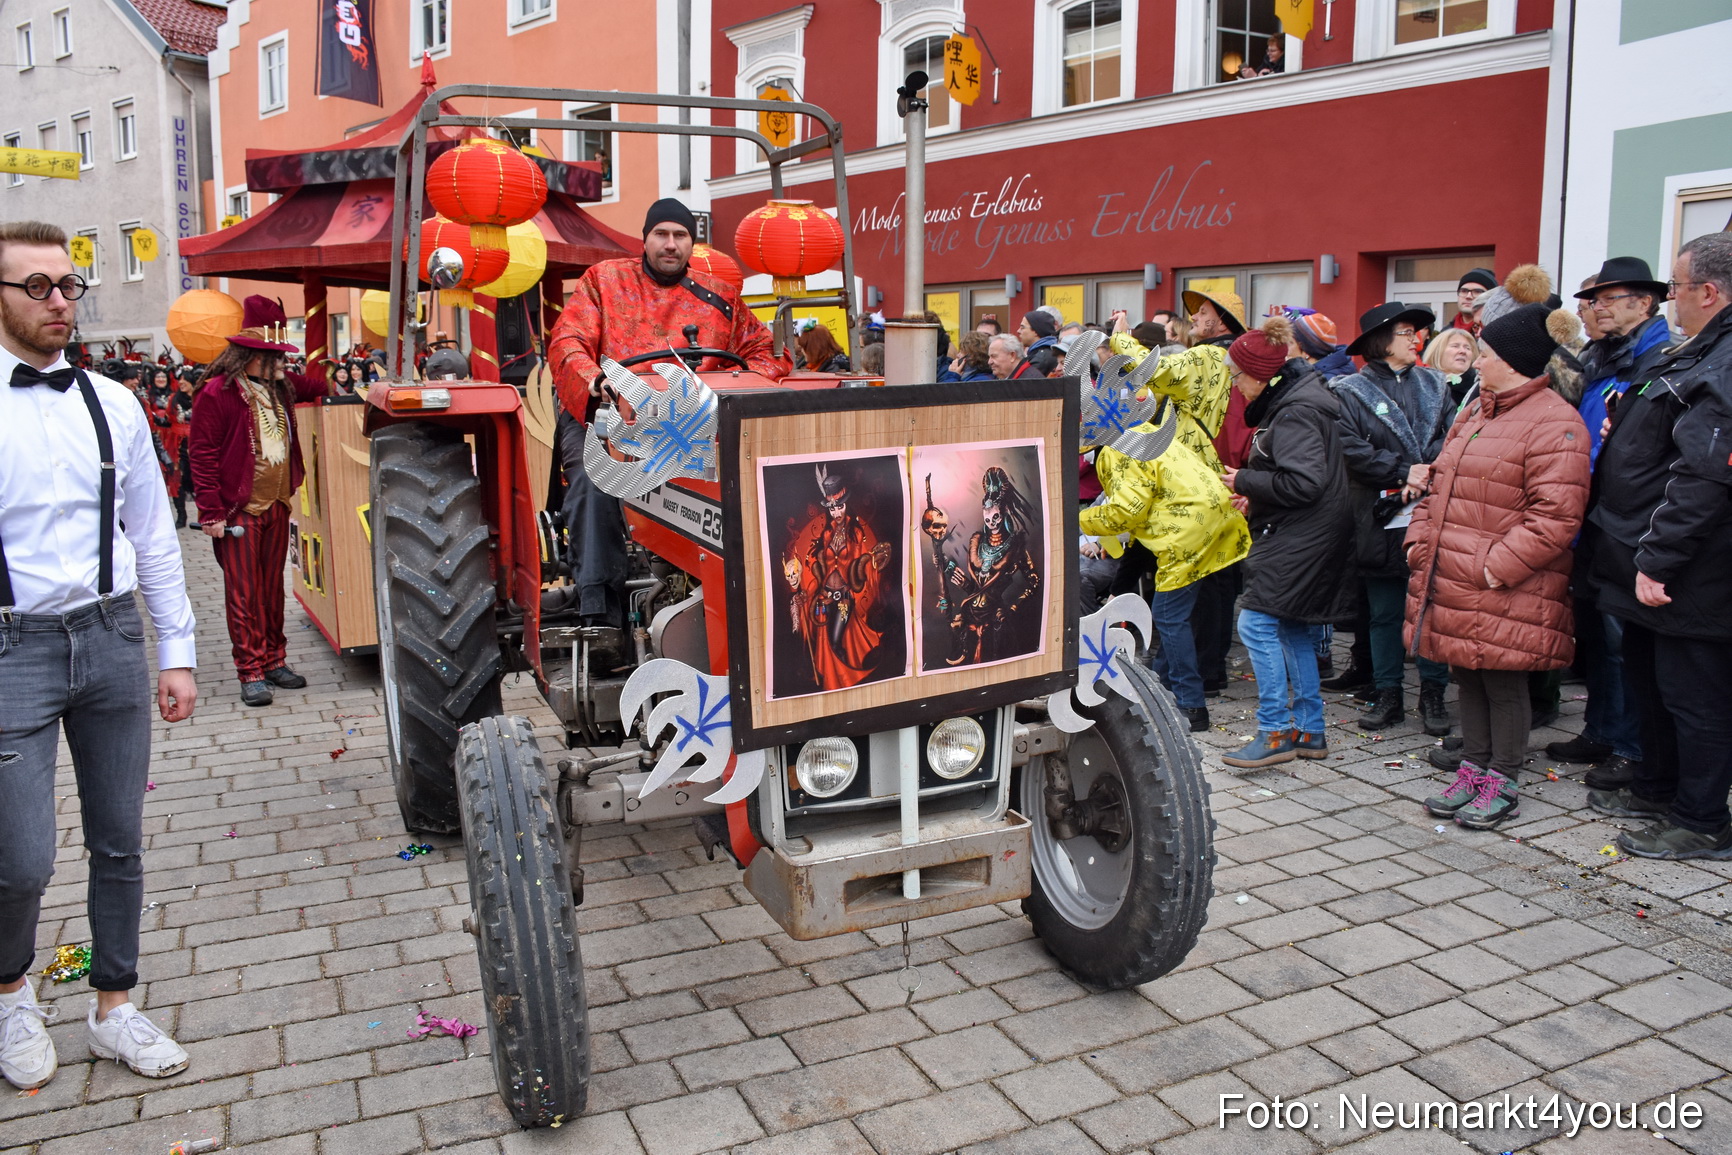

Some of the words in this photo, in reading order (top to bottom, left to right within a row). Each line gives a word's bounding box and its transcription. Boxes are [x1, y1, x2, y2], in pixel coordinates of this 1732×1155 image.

[174, 118, 188, 192] UHREN
[853, 191, 906, 235] Mode
[923, 202, 963, 224] enuss
[970, 173, 1044, 218] Erlebnis
[974, 211, 1075, 270] Genuss
[1090, 159, 1237, 238] Erlebnis
[179, 202, 193, 291] SCUC
[77, 295, 103, 325] XL
[662, 497, 679, 514] MASSEY
[680, 505, 702, 525] FERGUSON
